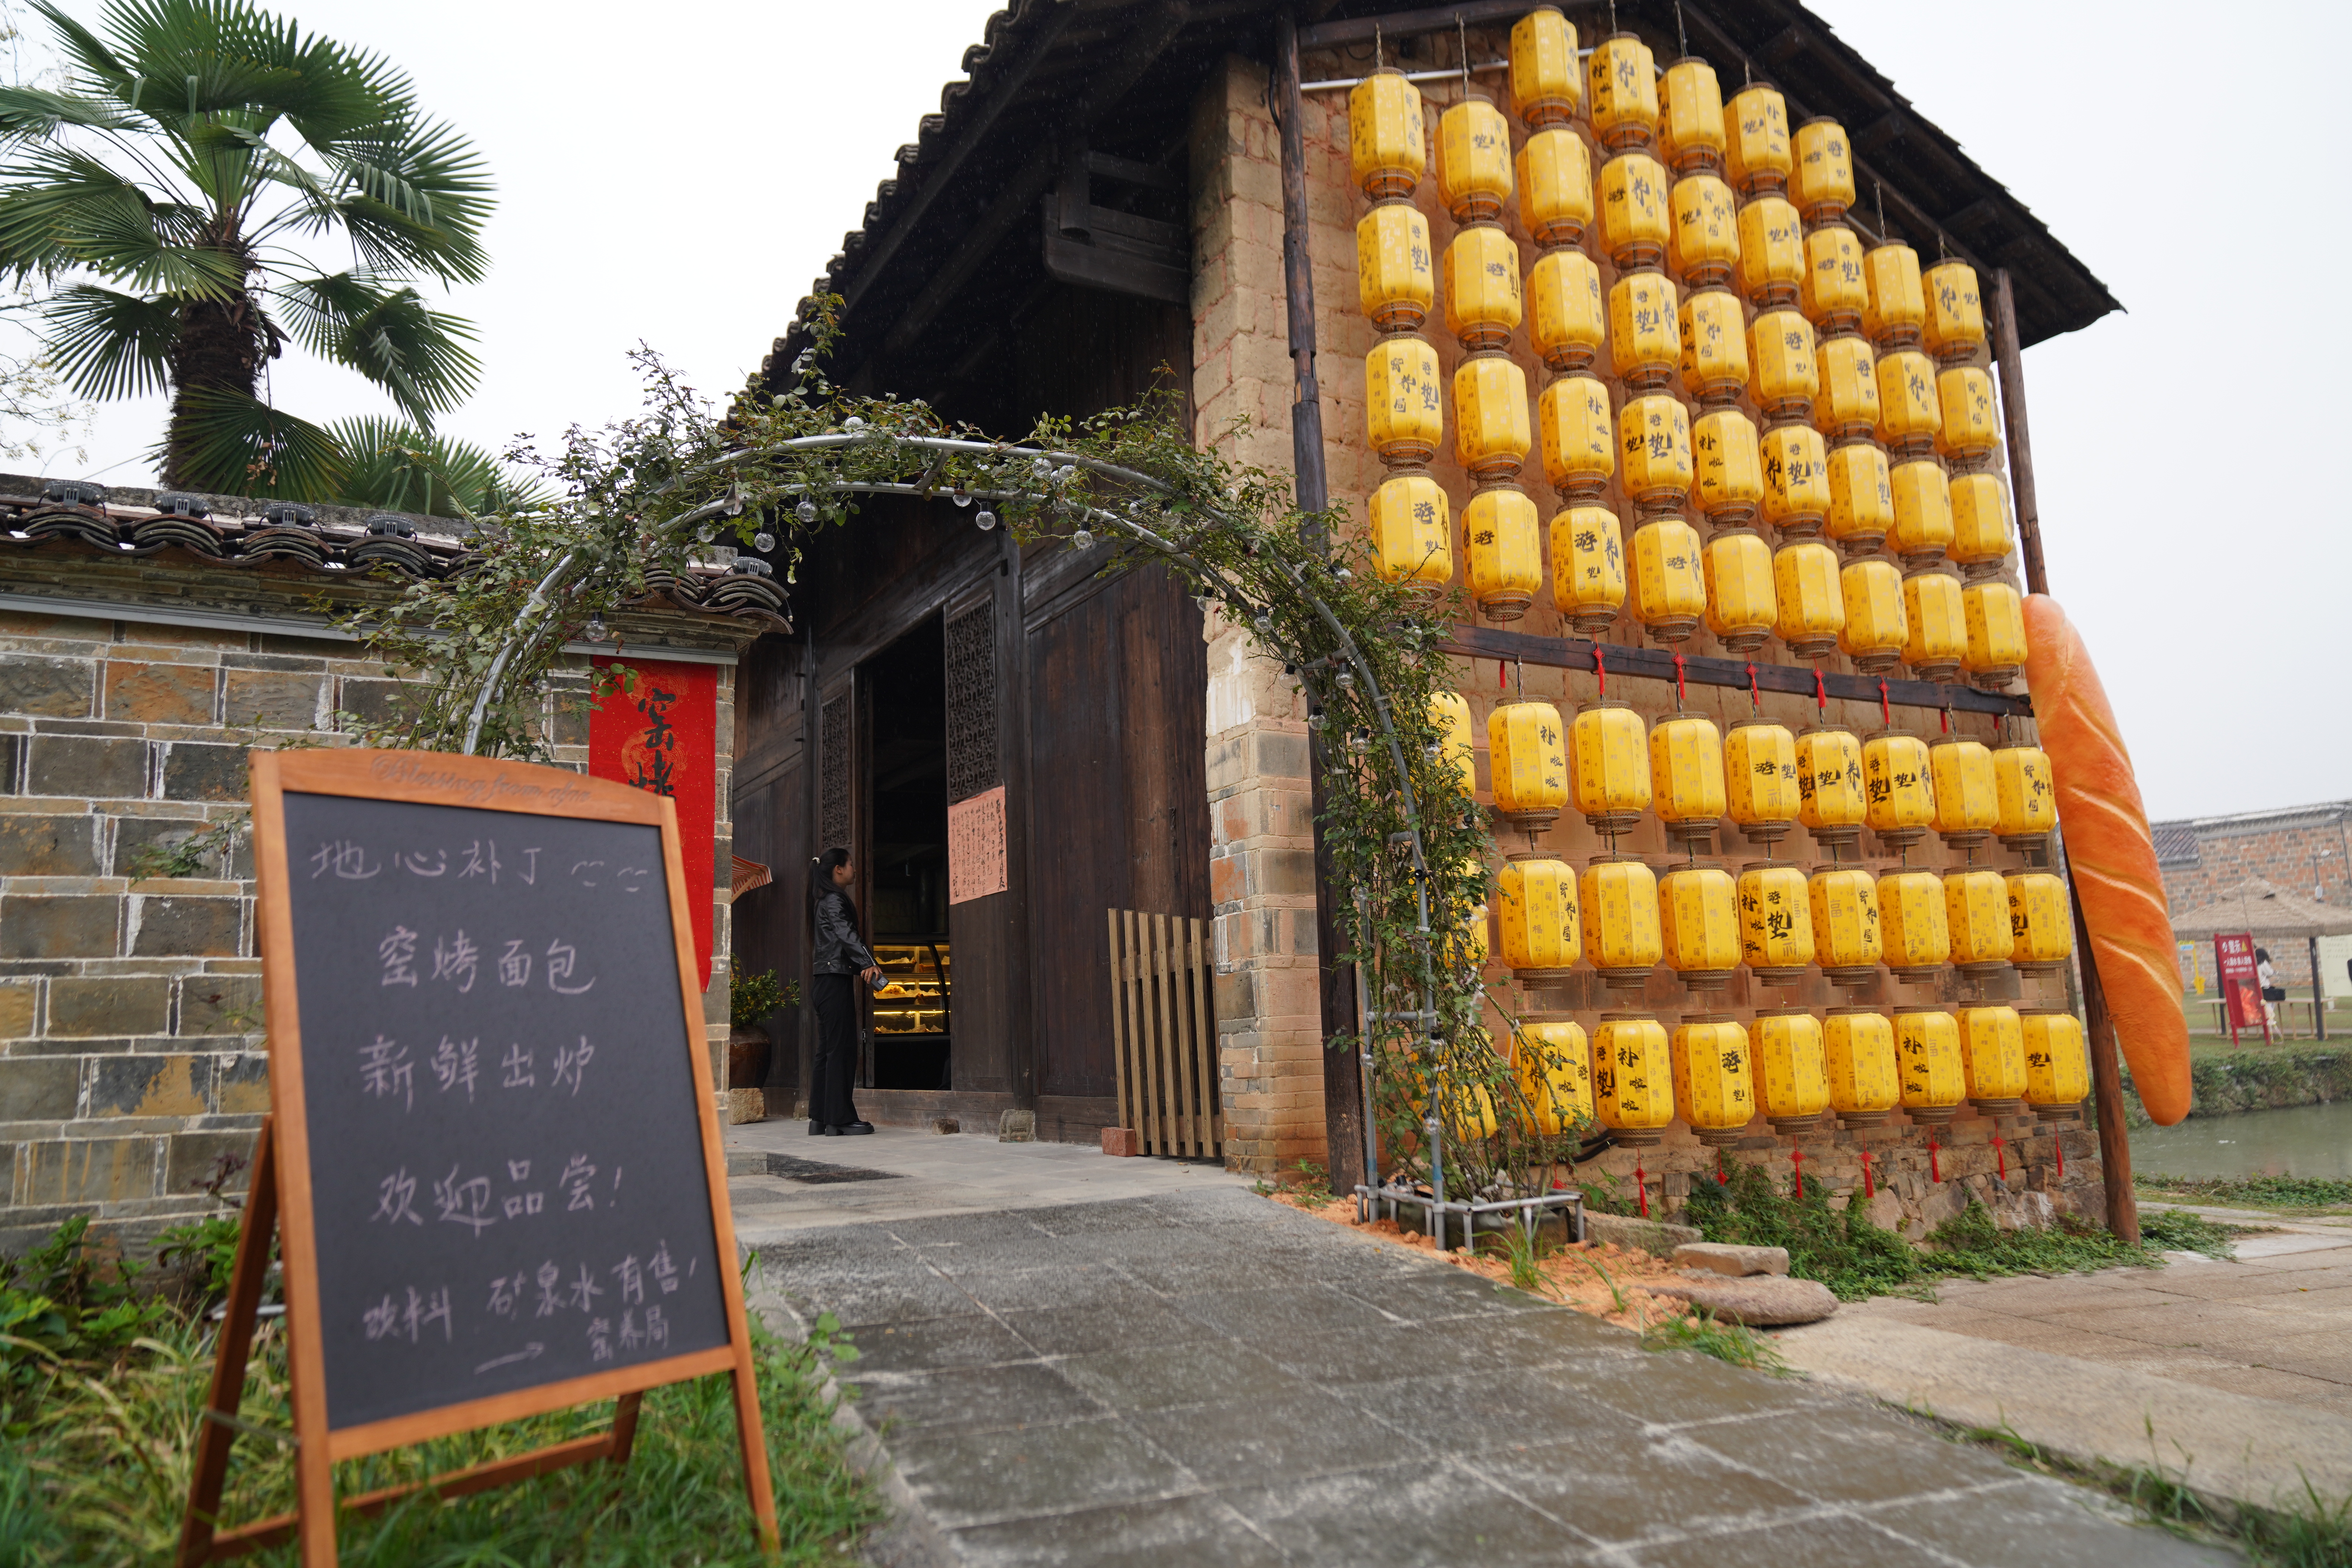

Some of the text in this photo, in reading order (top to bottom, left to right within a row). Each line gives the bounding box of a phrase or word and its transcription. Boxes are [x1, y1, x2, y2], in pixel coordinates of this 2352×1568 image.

[1540, 724, 1563, 788] 补啦啦
[311, 839, 542, 885] 地心补丁
[1767, 891, 1793, 940] 游垫
[380, 926, 596, 994] 窑烤面包
[360, 1035, 594, 1113] 新鲜出炉
[1618, 1046, 1647, 1112] 补啦啦
[1903, 1035, 1929, 1093] 补啦啦
